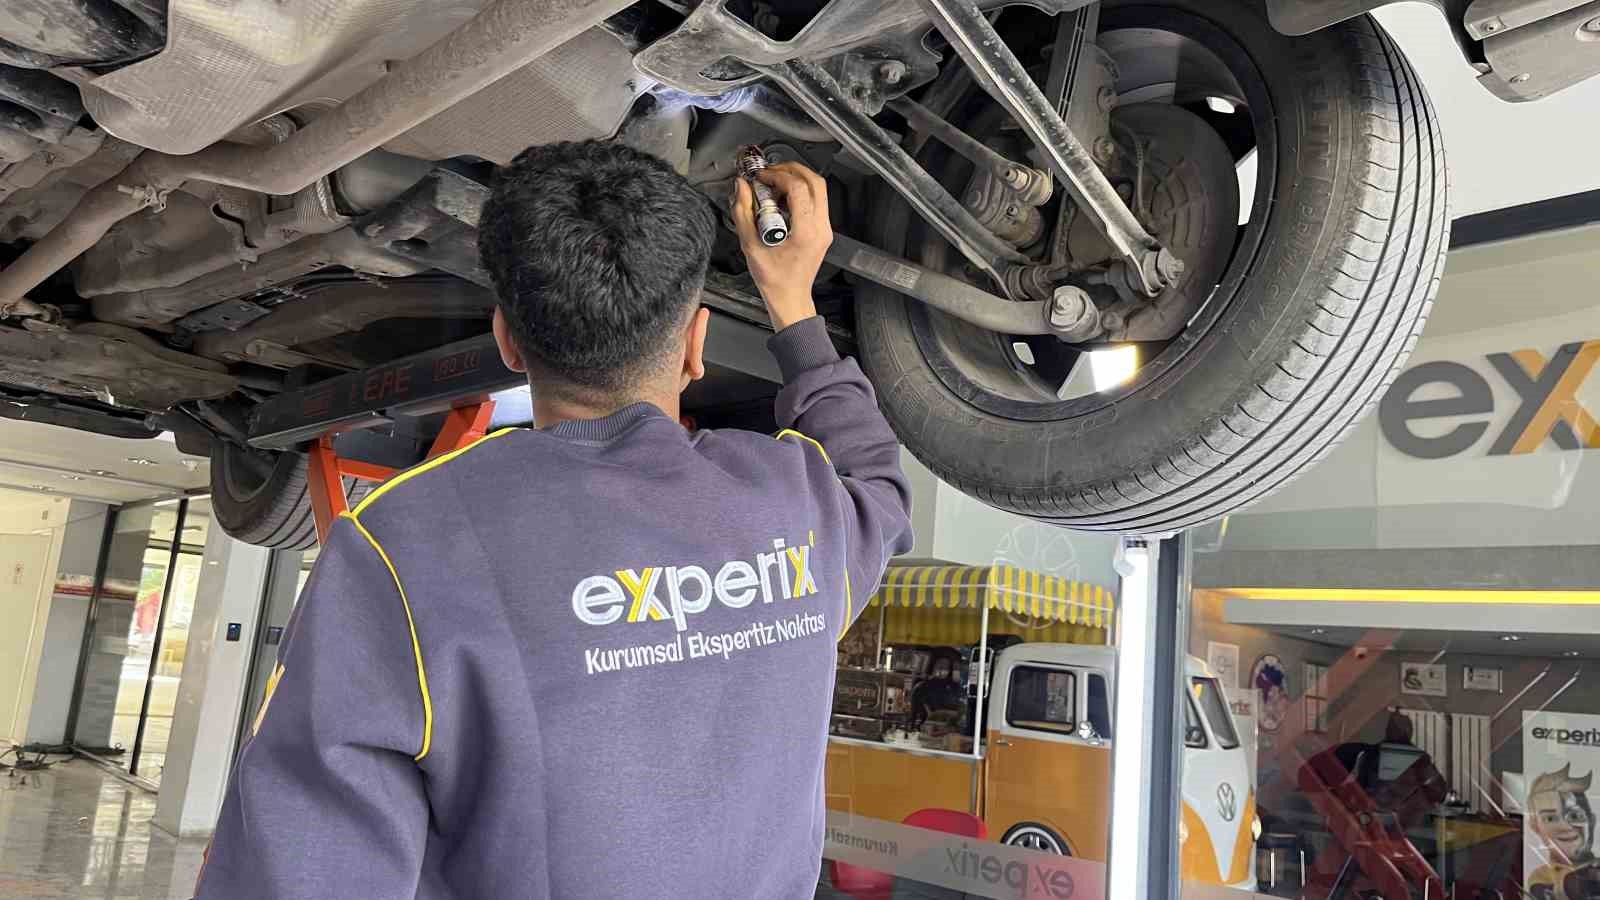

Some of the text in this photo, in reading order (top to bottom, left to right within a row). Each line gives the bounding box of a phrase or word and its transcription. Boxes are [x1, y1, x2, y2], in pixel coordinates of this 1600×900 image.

[572, 538, 818, 631] experix
[585, 634, 684, 674] Kurumsal
[688, 622, 776, 659] Ekspertiz
